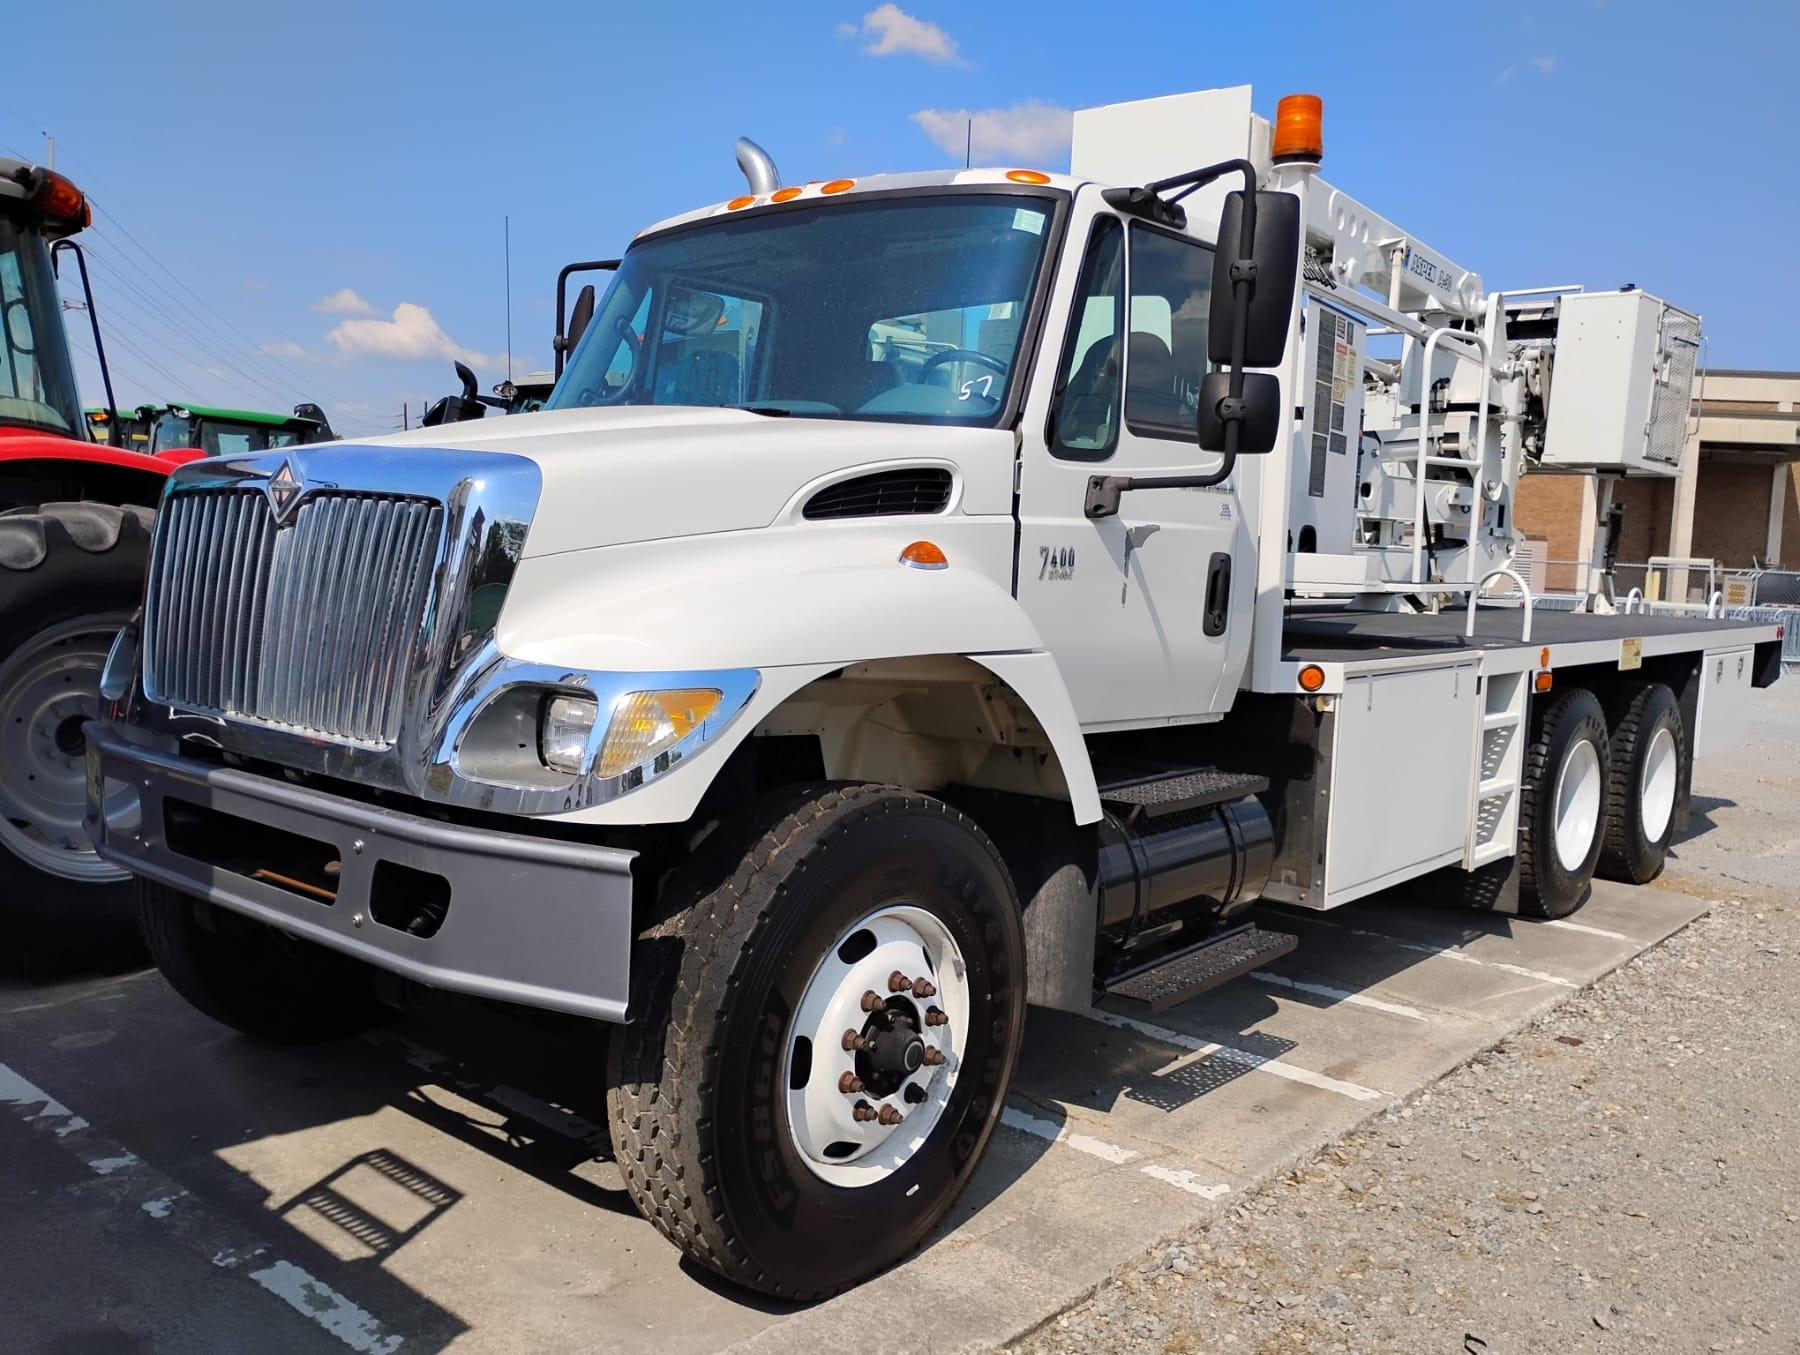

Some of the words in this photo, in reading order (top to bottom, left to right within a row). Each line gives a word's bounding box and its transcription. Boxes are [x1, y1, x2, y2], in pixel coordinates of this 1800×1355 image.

[1410, 253, 1437, 283] ASPEN
[958, 374, 993, 401] 57
[1038, 546, 1075, 581] 7400
